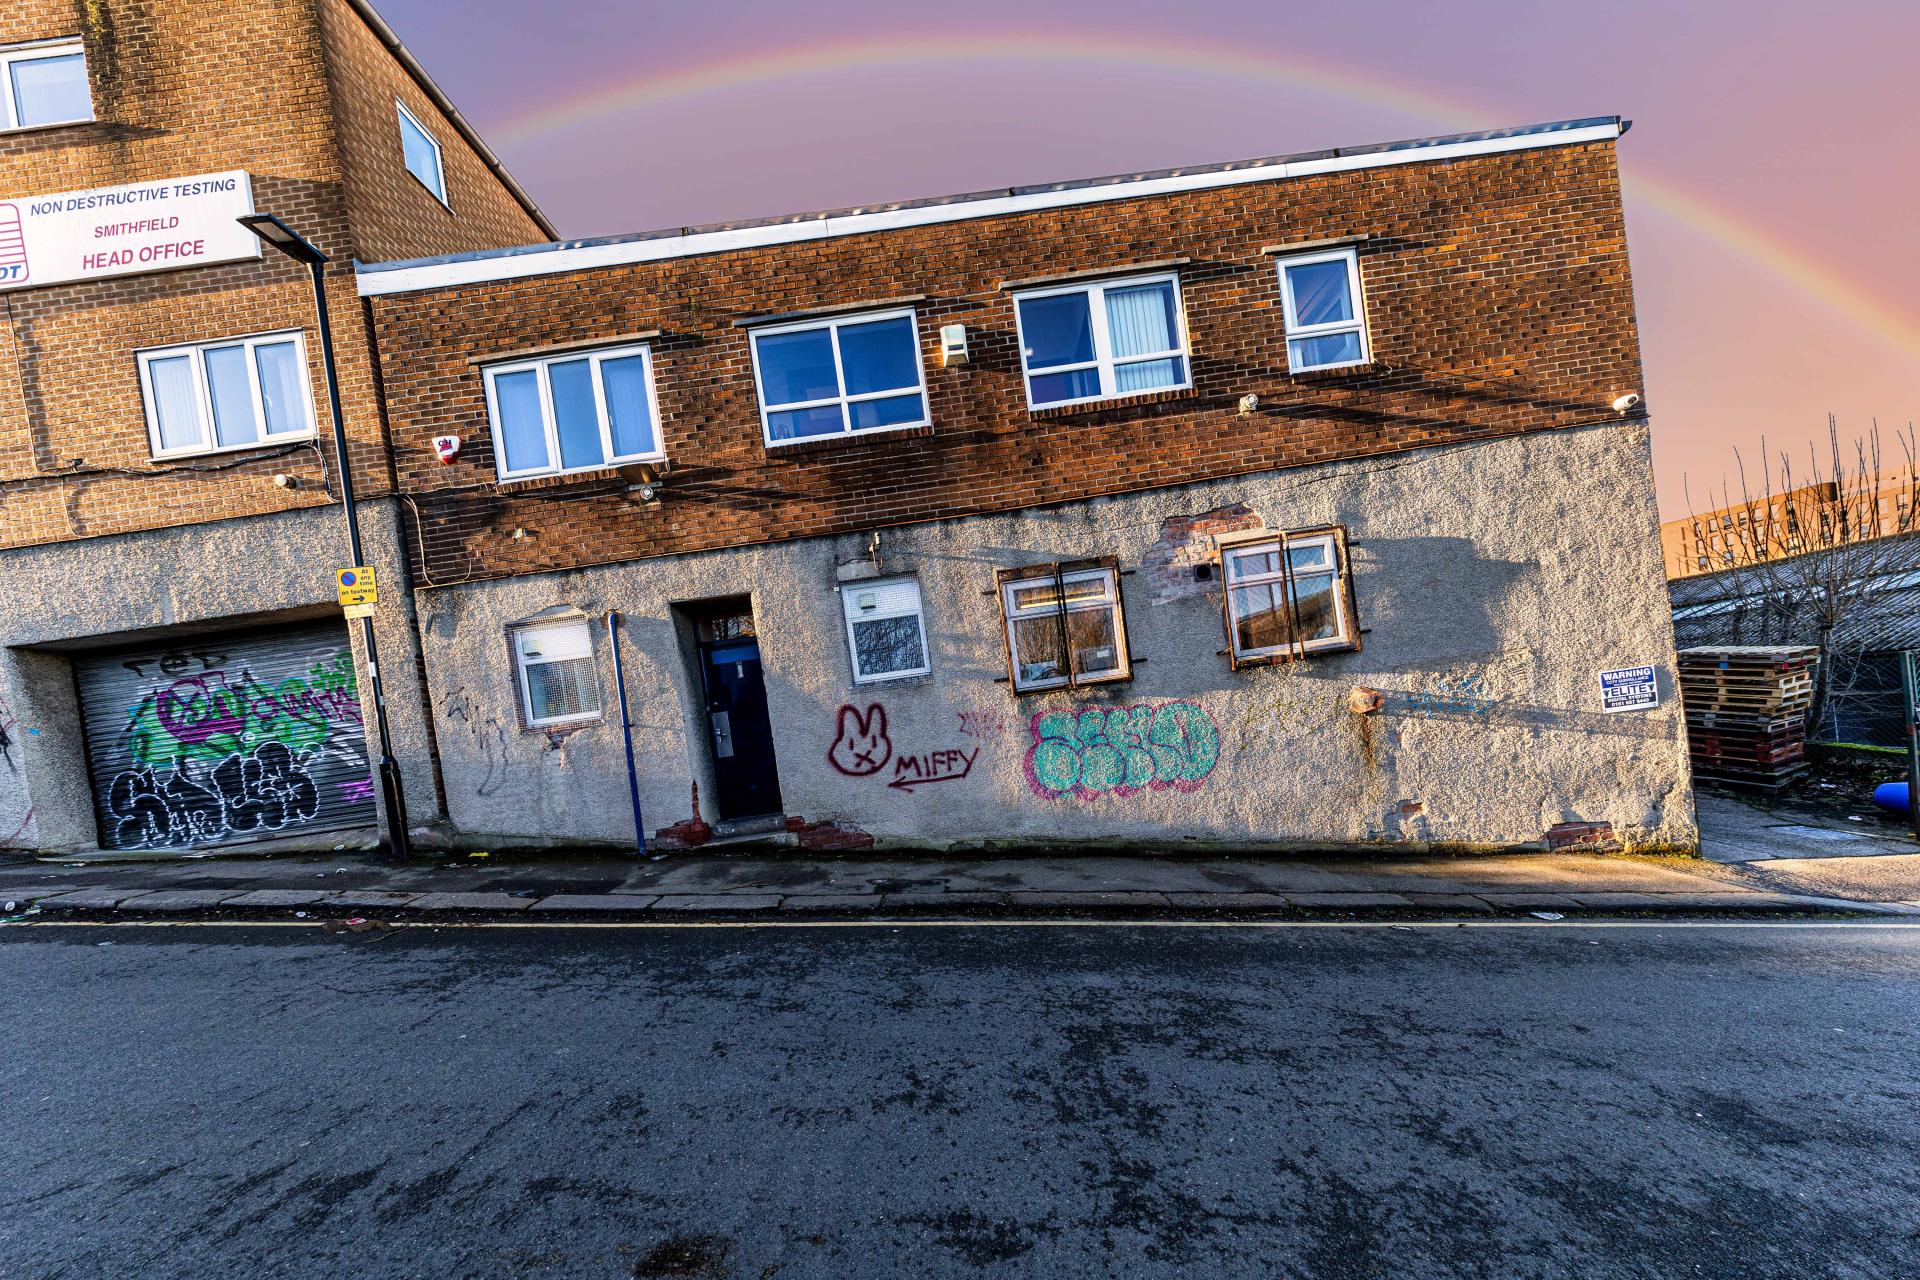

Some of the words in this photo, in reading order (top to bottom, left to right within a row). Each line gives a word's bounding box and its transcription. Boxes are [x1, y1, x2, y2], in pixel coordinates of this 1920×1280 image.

[30, 200, 63, 216] NON
[66, 187, 169, 212] DESTRUCTIVE
[174, 178, 236, 198] TESTING
[94, 216, 180, 238] SMITHFIELD
[83, 247, 133, 270] HEAD
[139, 239, 205, 262] OFFICE
[1603, 668, 1651, 680] WARNING
[1612, 684, 1647, 696] ELITE
[895, 747, 980, 778] MIFFY
